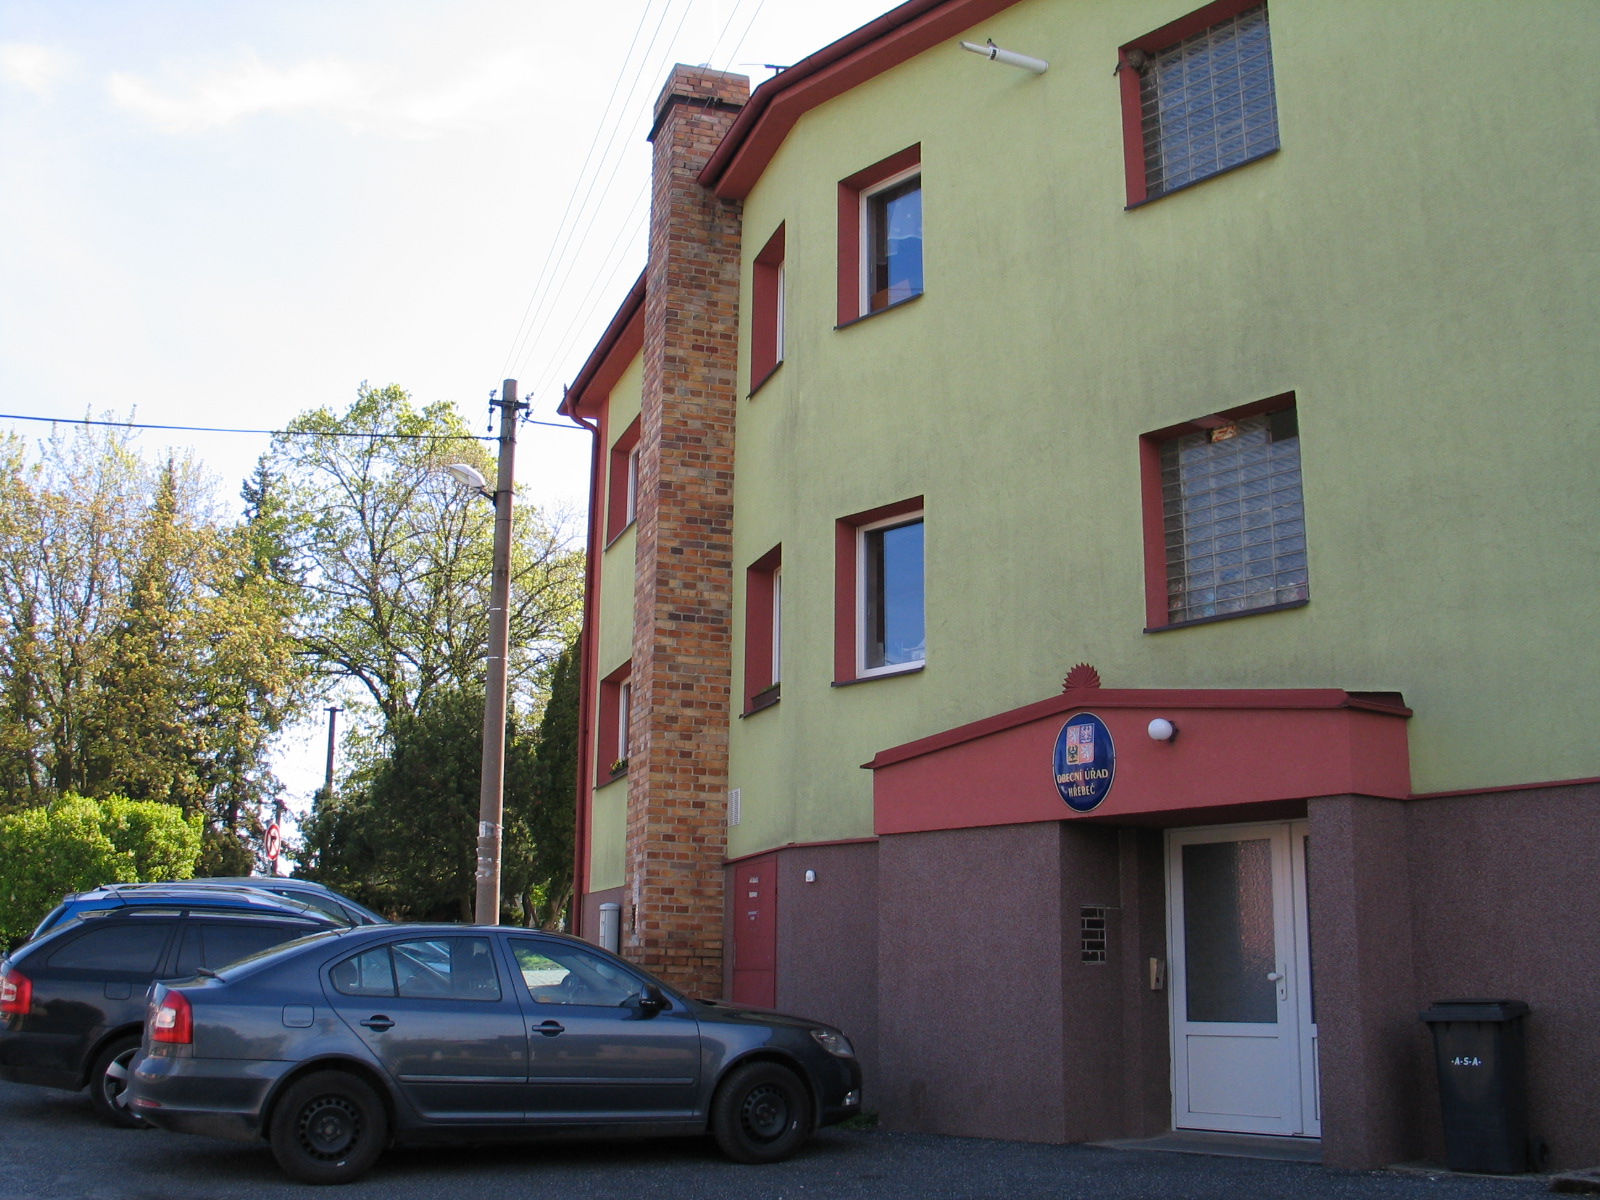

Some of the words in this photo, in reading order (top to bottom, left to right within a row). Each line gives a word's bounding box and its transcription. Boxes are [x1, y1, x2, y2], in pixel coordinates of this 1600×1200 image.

[1057, 770, 1082, 784] OBECNÍ
[1085, 768, 1108, 780] ÚŘAD
[1068, 783, 1095, 797] HŘEBEČ
